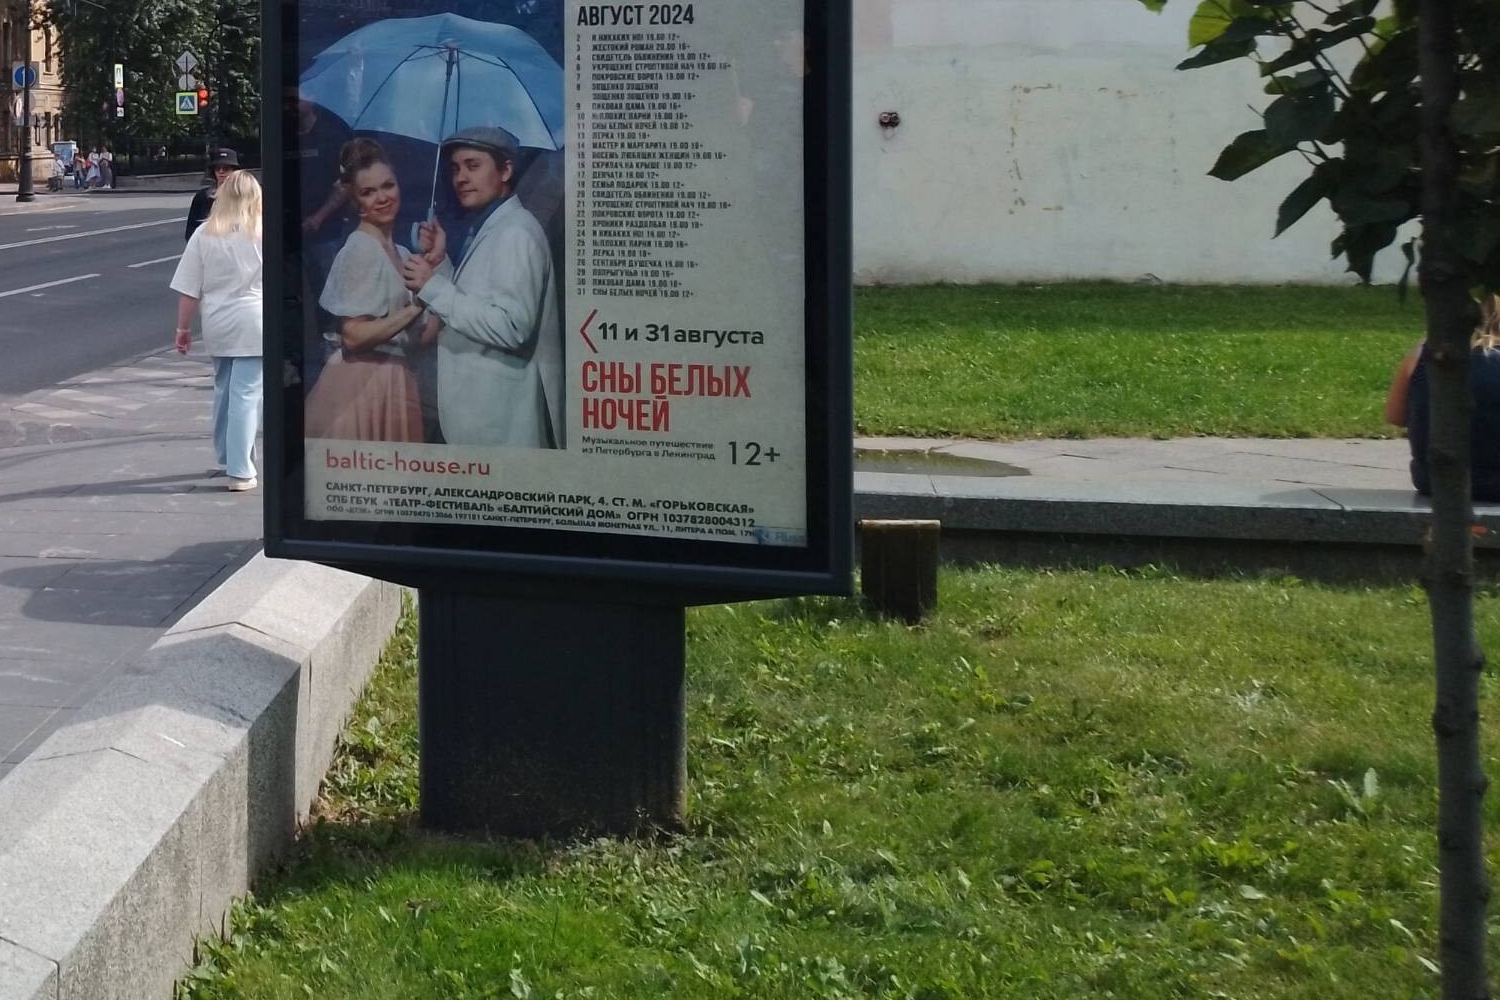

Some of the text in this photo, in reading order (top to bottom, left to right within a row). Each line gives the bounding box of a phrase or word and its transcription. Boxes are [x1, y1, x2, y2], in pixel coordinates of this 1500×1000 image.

[577, 4, 695, 26] АВГУСТ 2024
[598, 322, 765, 348] 11 и 31 августа
[582, 360, 752, 398] СНЫ БЕЛЫХ
[582, 395, 670, 432] НОЧЕЙ
[581, 436, 714, 450] Музыкальное путешествие
[595, 446, 652, 458] Петербурга
[661, 449, 716, 461] Ленинград
[727, 441, 781, 466] 12+
[326, 449, 491, 476] baltic-house.ru
[326, 482, 432, 497] САНКТ-ПЕТЕРБУРГ,
[434, 487, 555, 503] АЛЕКСАНДРОВСКИЙ
[558, 494, 595, 506] ПАРК,
[612, 497, 629, 508] СТ.
[632, 498, 647, 509] М.
[650, 499, 755, 514] «ГОРЬКОВСКАЯ»
[326, 494, 755, 527] СПБ ГБУК «ТЕАТР-ФЕСТИВАЛЬ «БАЛТИЙСКИЙ ДОМ» ОГРН 1037828004312
